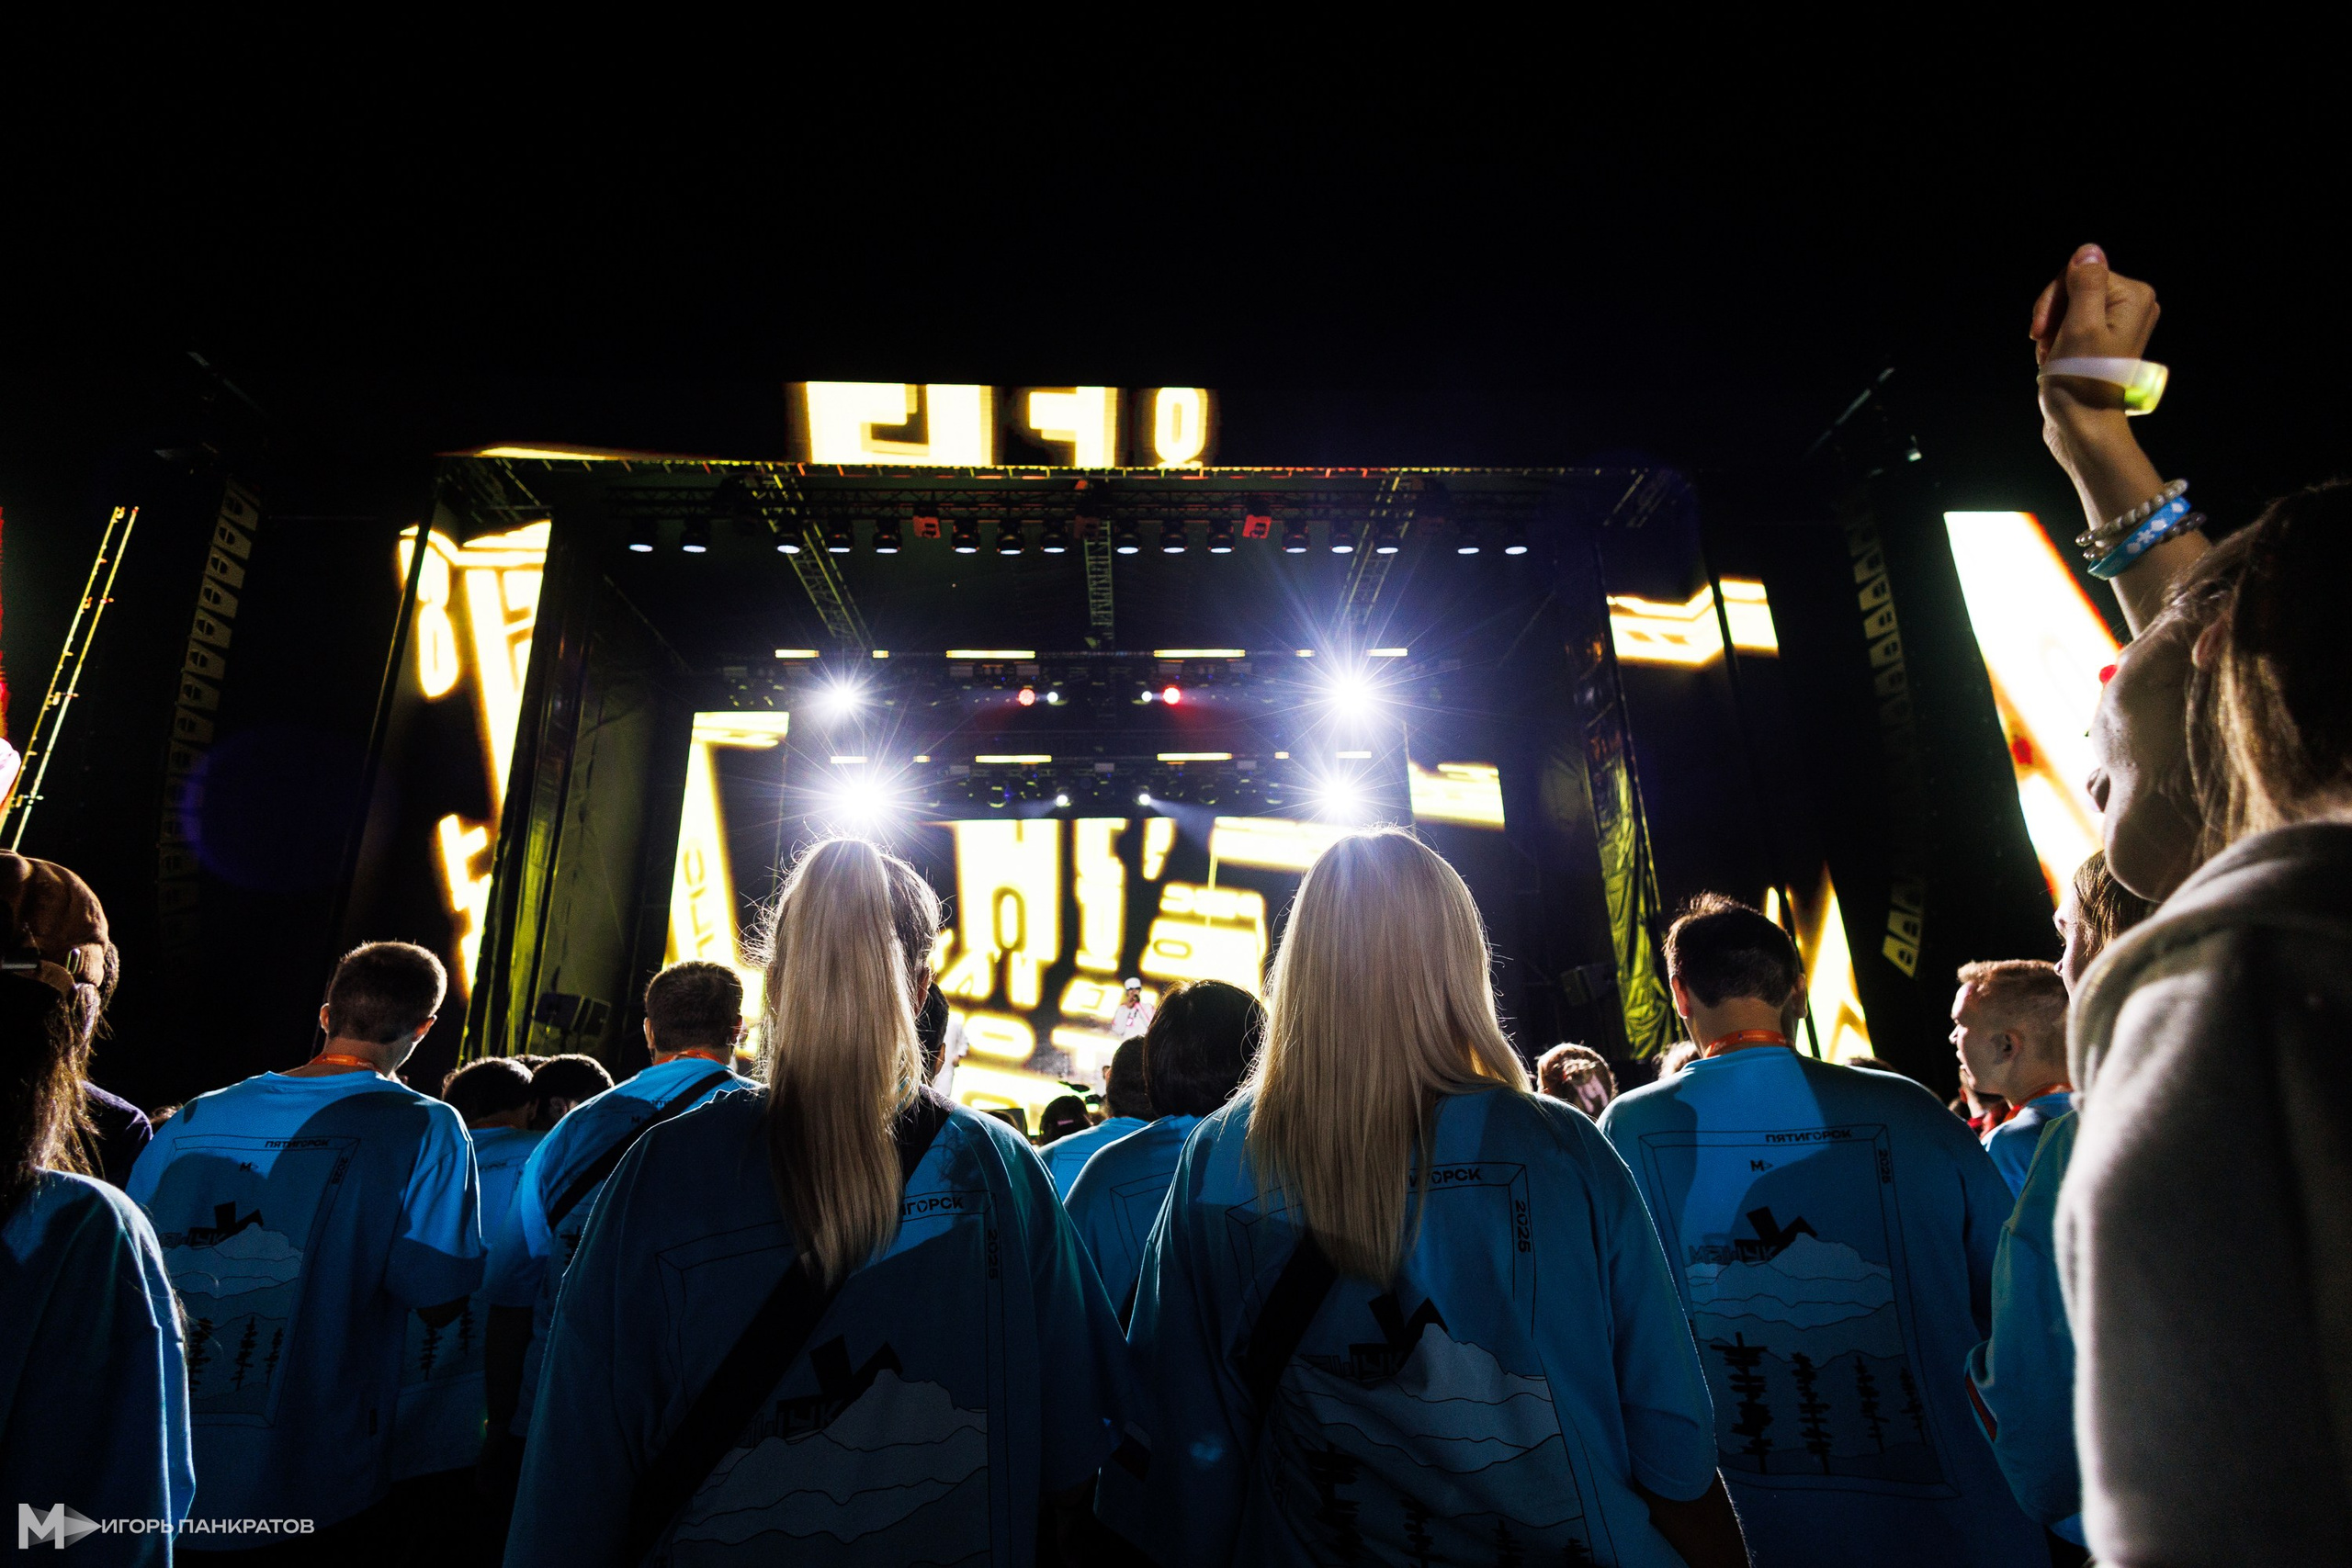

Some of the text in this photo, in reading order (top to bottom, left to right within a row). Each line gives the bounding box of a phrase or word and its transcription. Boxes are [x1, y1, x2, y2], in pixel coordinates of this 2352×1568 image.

[1765, 1130, 1852, 1143] ПЯТИГОРСК
[1878, 1148, 1892, 1184] 2025
[1514, 1199, 1532, 1254] 2025
[987, 1227, 1000, 1280] 2025
